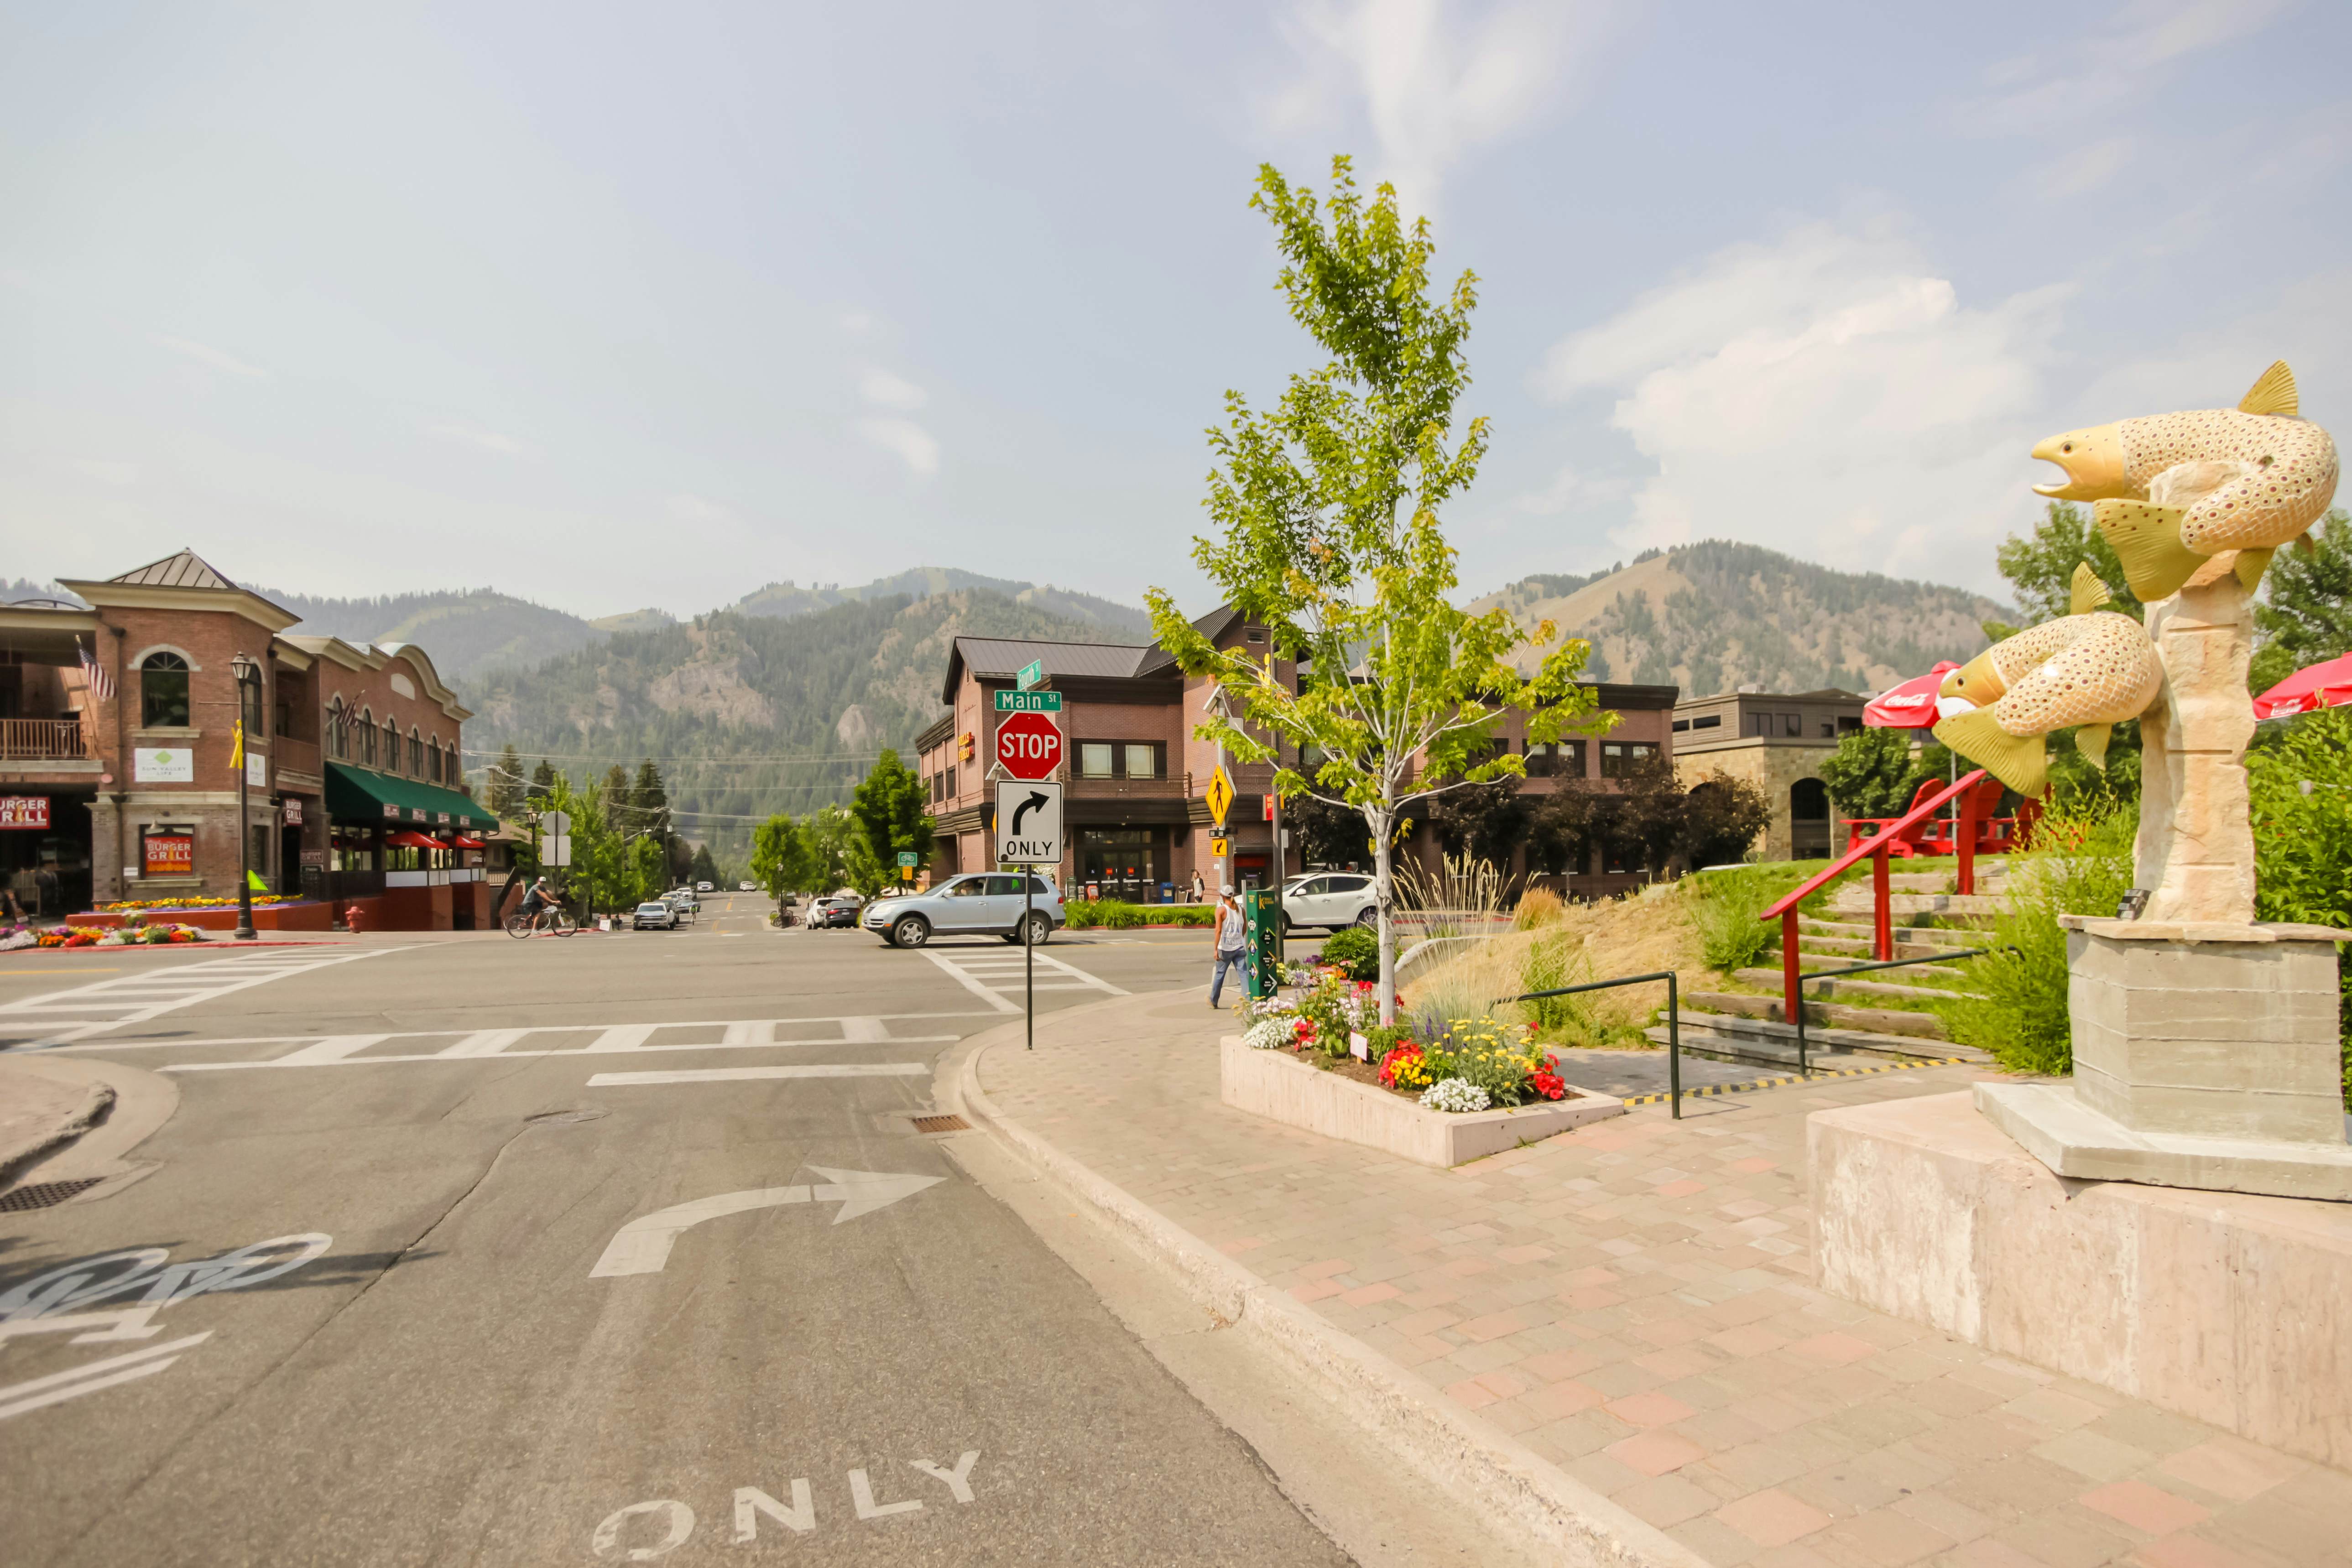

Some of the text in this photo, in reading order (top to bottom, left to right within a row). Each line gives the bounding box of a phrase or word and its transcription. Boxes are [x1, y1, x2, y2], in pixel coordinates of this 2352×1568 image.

[1019, 666, 1034, 688] Fourth
[1002, 692, 1056, 709] Main St
[959, 732, 970, 747] WELLS
[1001, 733, 1058, 759] STOP
[959, 747, 970, 762] FARGO
[0, 800, 47, 810] URGER
[2, 811, 47, 822] RILL
[1007, 841, 1053, 855] ONLY
[592, 1450, 981, 1561] ONLY
